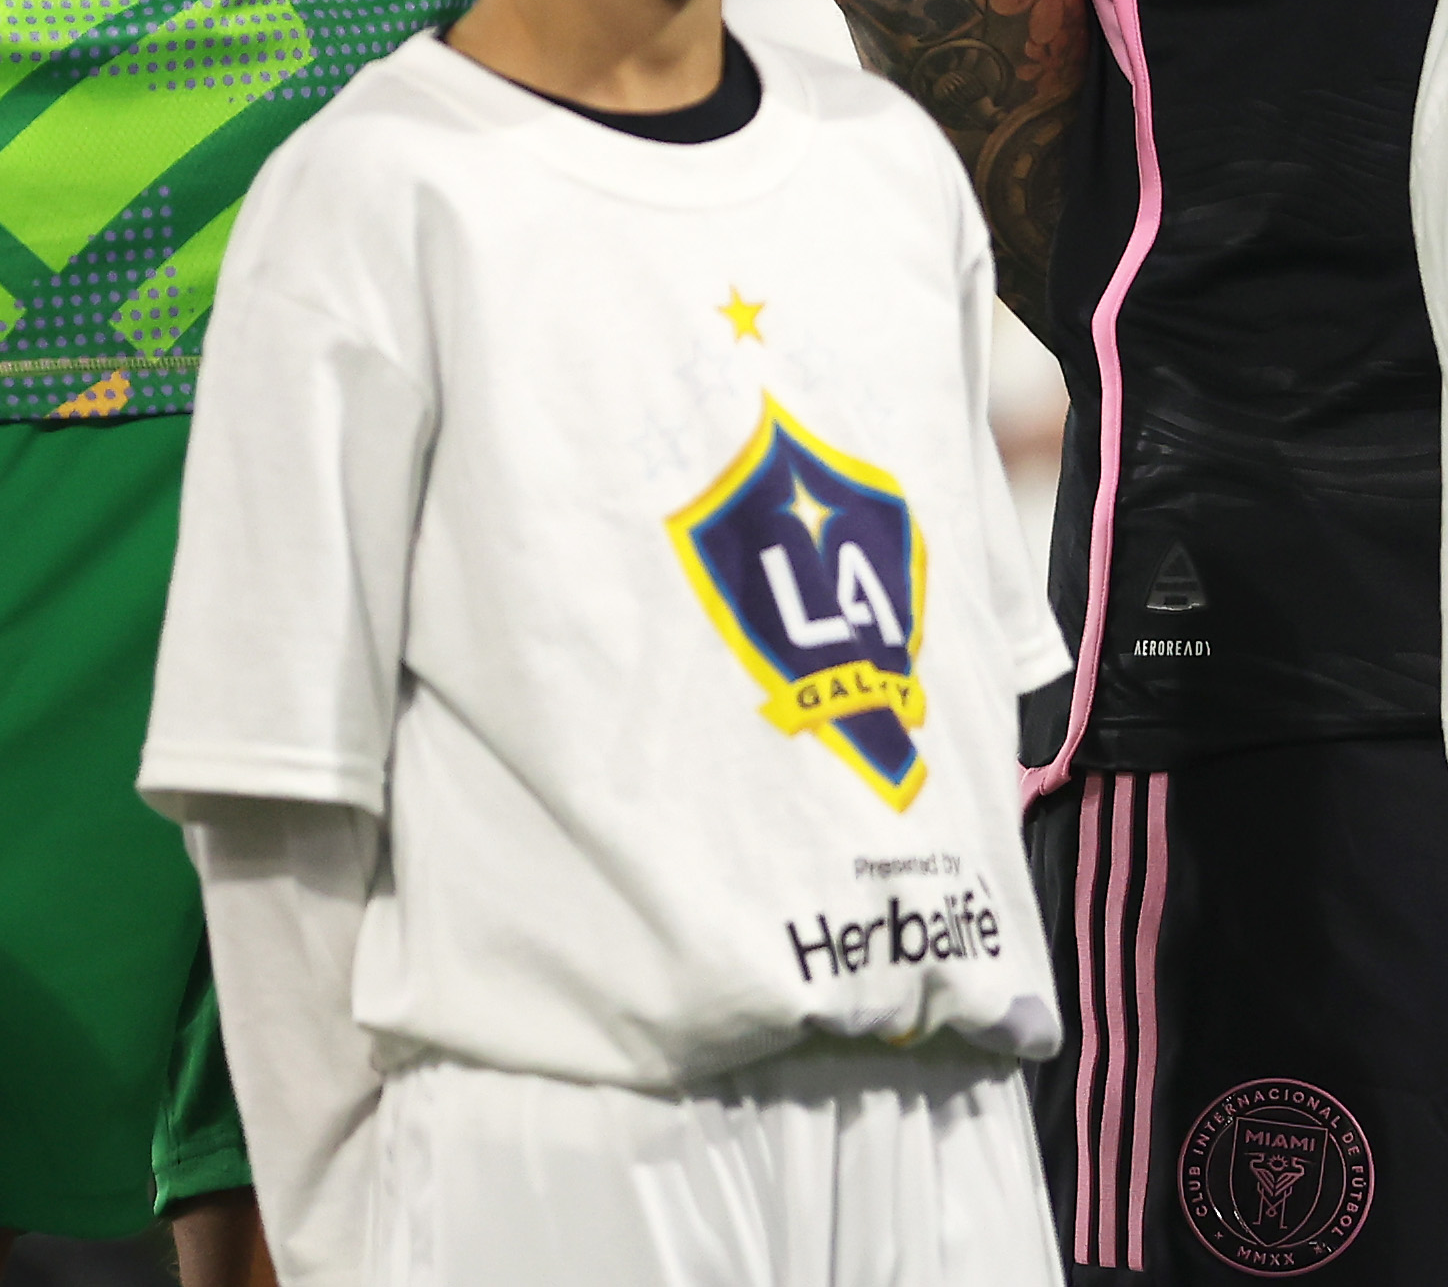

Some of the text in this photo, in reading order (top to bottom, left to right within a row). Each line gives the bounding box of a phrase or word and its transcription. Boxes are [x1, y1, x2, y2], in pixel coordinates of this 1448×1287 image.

[758, 540, 908, 650] LA
[795, 670, 910, 710] GALY
[786, 890, 1001, 982] Herbalife
[1193, 1088, 1341, 1155] INTERNACIONAL
[1245, 1129, 1316, 1152] MIAMI
[1341, 1131, 1360, 1156] DE
[1188, 1166, 1209, 1217] CLUB
[1237, 1245, 1295, 1266] MMXX
